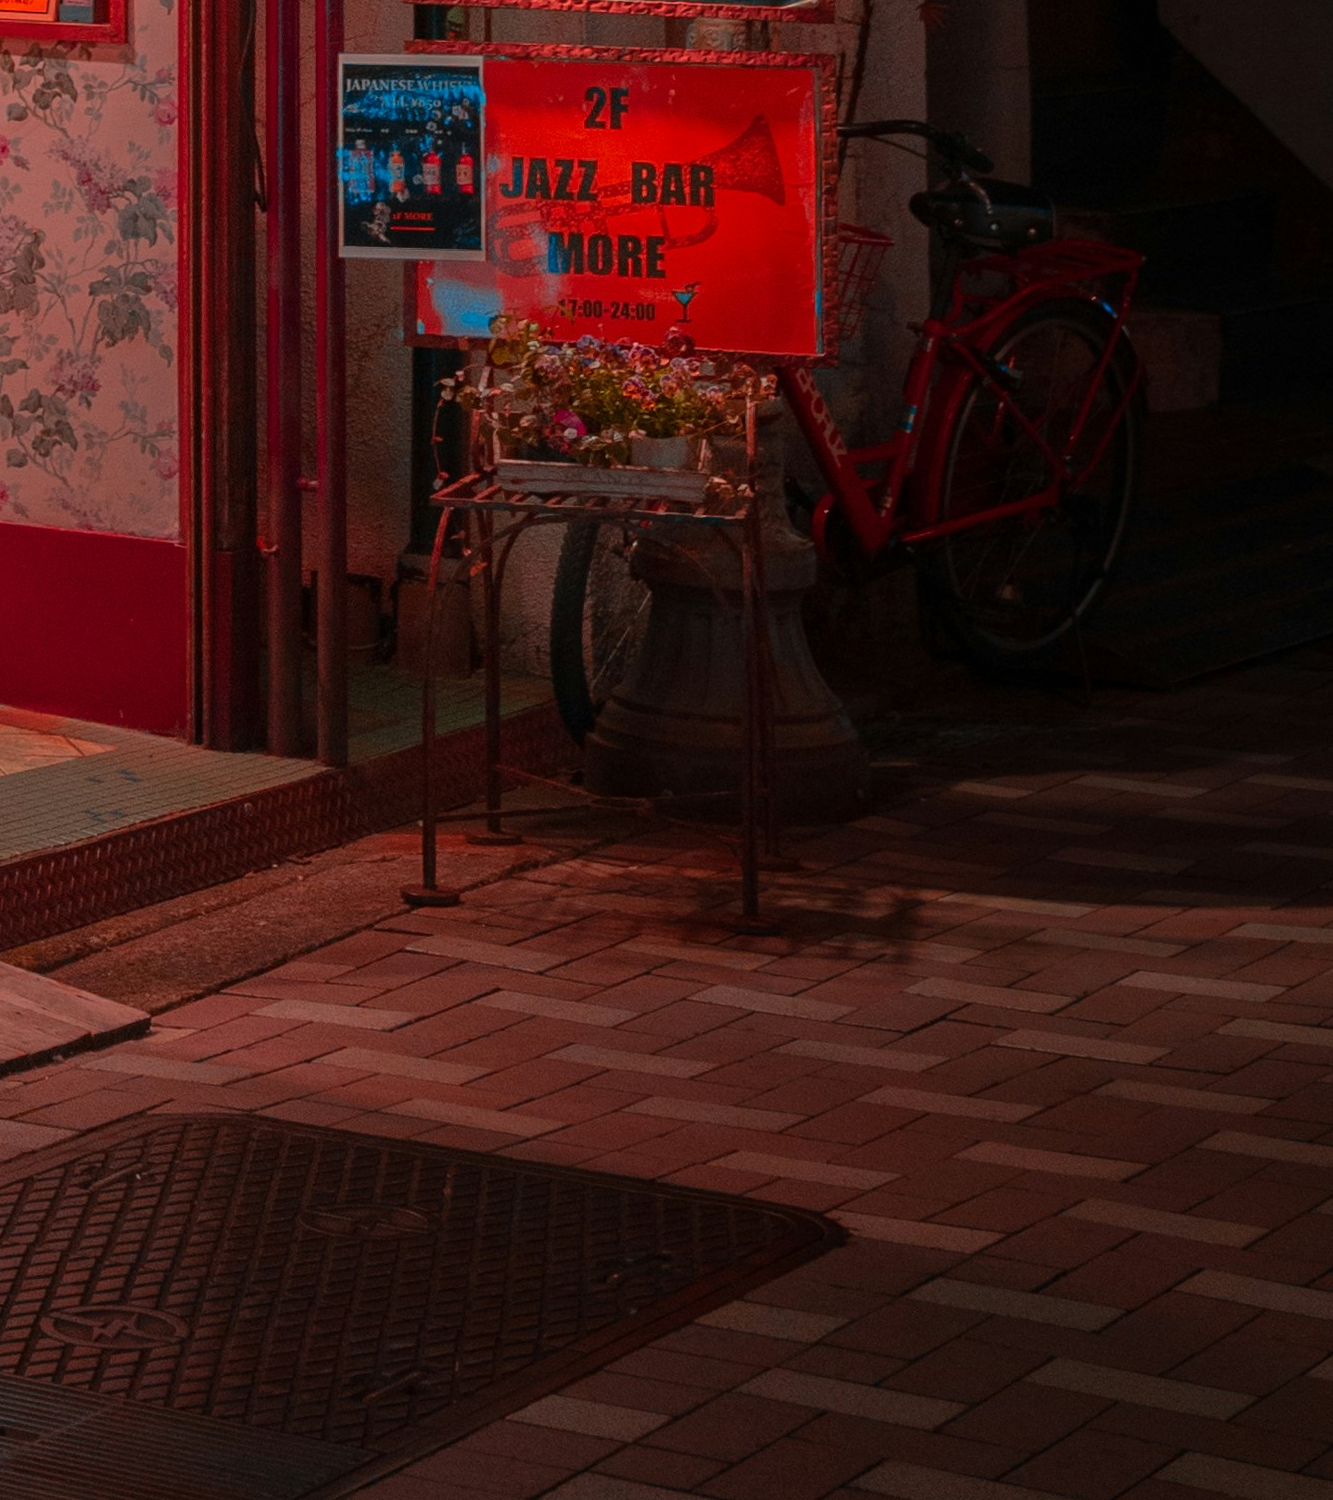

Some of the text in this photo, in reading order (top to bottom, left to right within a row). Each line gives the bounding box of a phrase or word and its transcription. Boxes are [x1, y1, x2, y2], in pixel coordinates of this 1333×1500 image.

[345, 78, 416, 93] JAPANESE
[583, 85, 631, 131] 2F
[498, 156, 717, 207] JAZZ BAR
[548, 233, 667, 279] MORE
